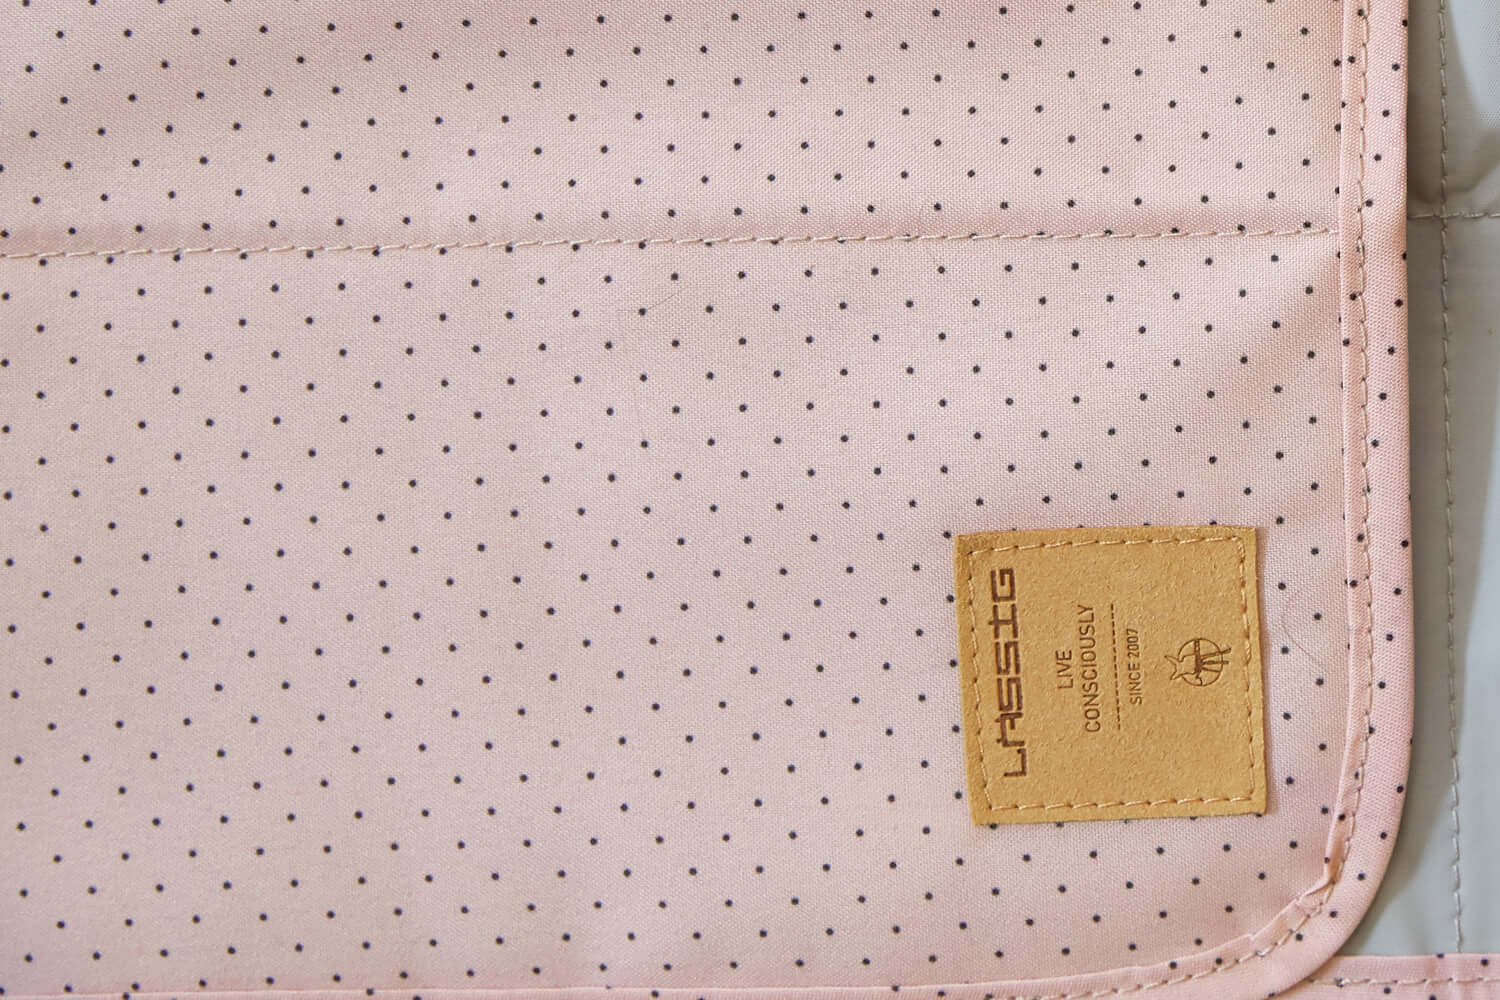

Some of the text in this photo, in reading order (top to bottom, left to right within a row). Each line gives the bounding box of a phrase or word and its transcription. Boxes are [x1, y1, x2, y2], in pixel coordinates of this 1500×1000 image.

[1055, 649, 1074, 690] LIVE
[1077, 603, 1101, 733] CONSCIOUSLY
[1126, 628, 1143, 706] SINCE 2007
